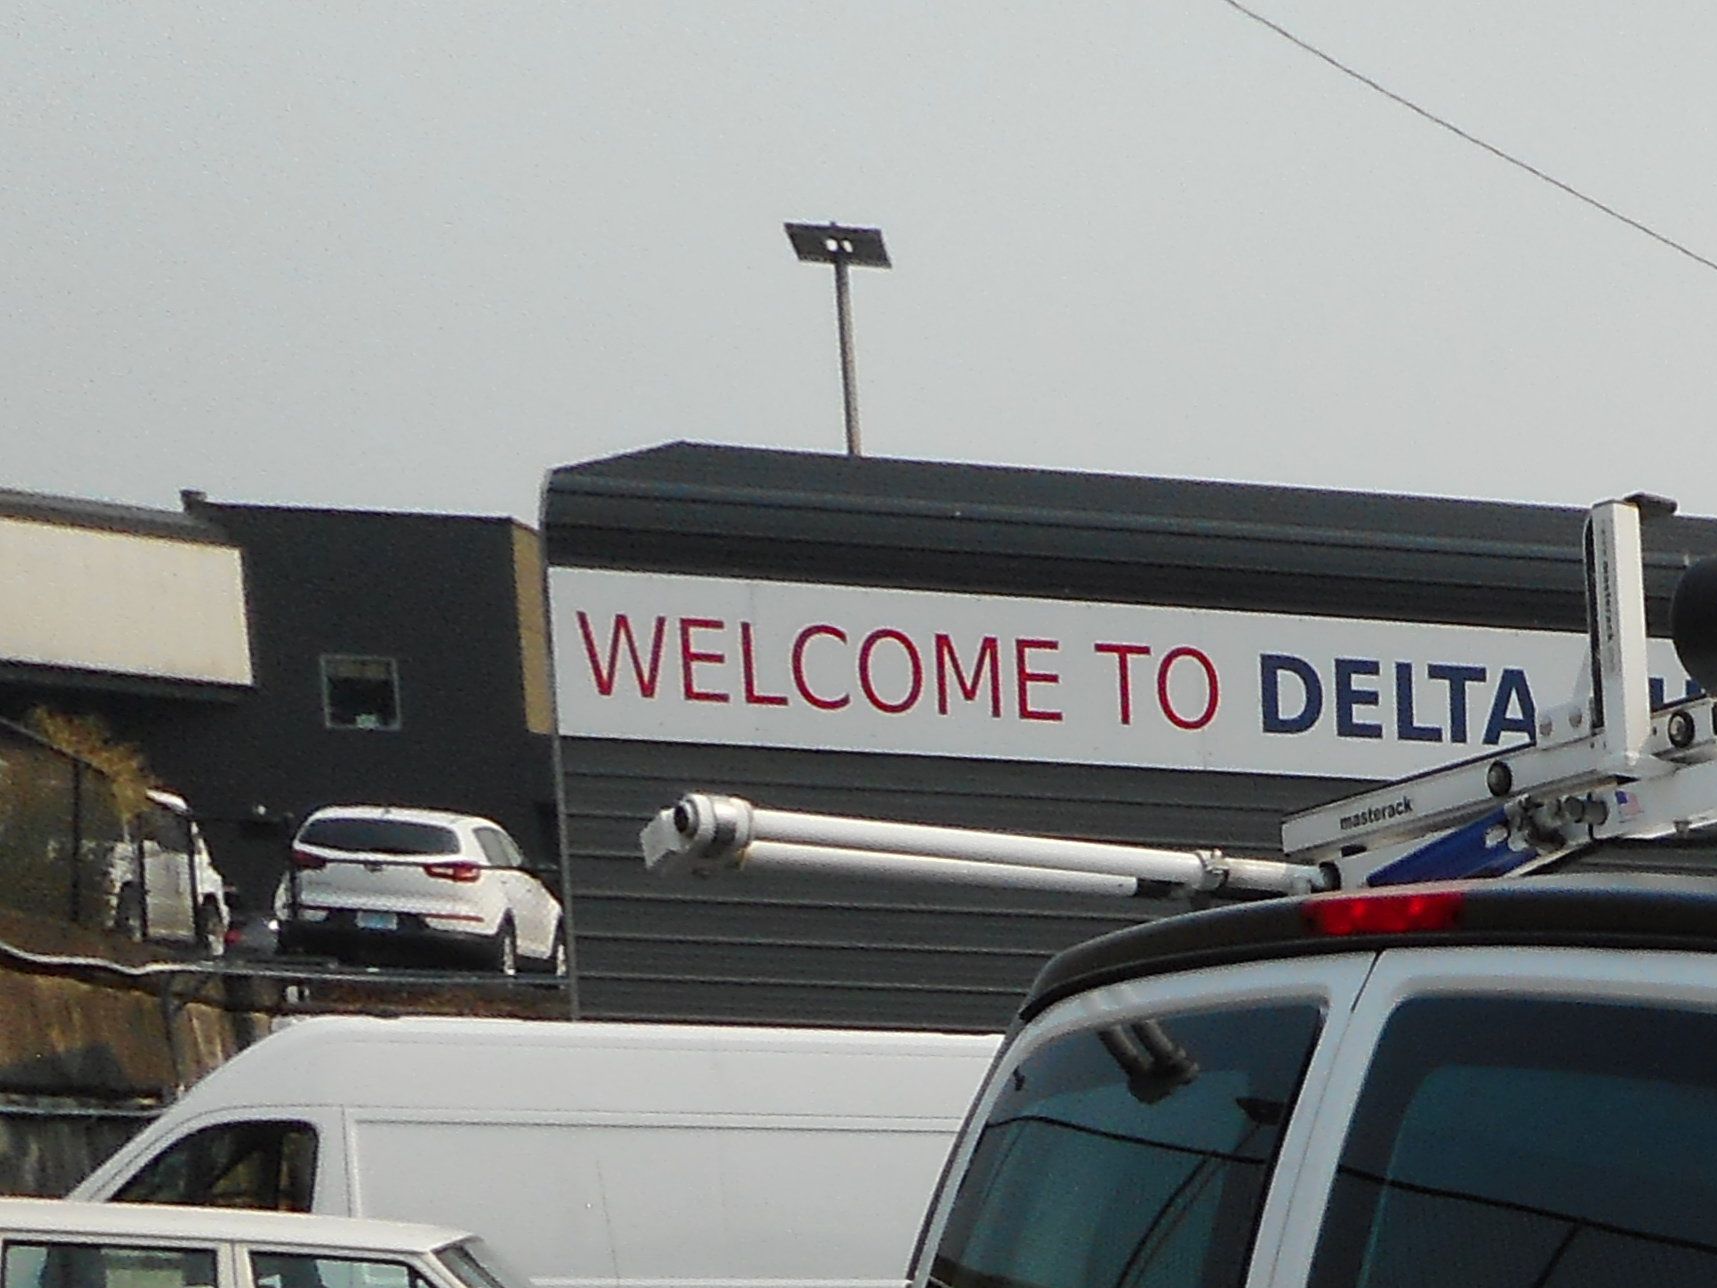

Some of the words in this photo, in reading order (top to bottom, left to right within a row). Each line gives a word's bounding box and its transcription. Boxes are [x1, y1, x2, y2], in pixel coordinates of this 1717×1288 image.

[576, 610, 1064, 722] WELCOME
[1094, 642, 1220, 731] TO
[1260, 652, 1538, 746] DELTA
[1340, 795, 1414, 831] masterack
